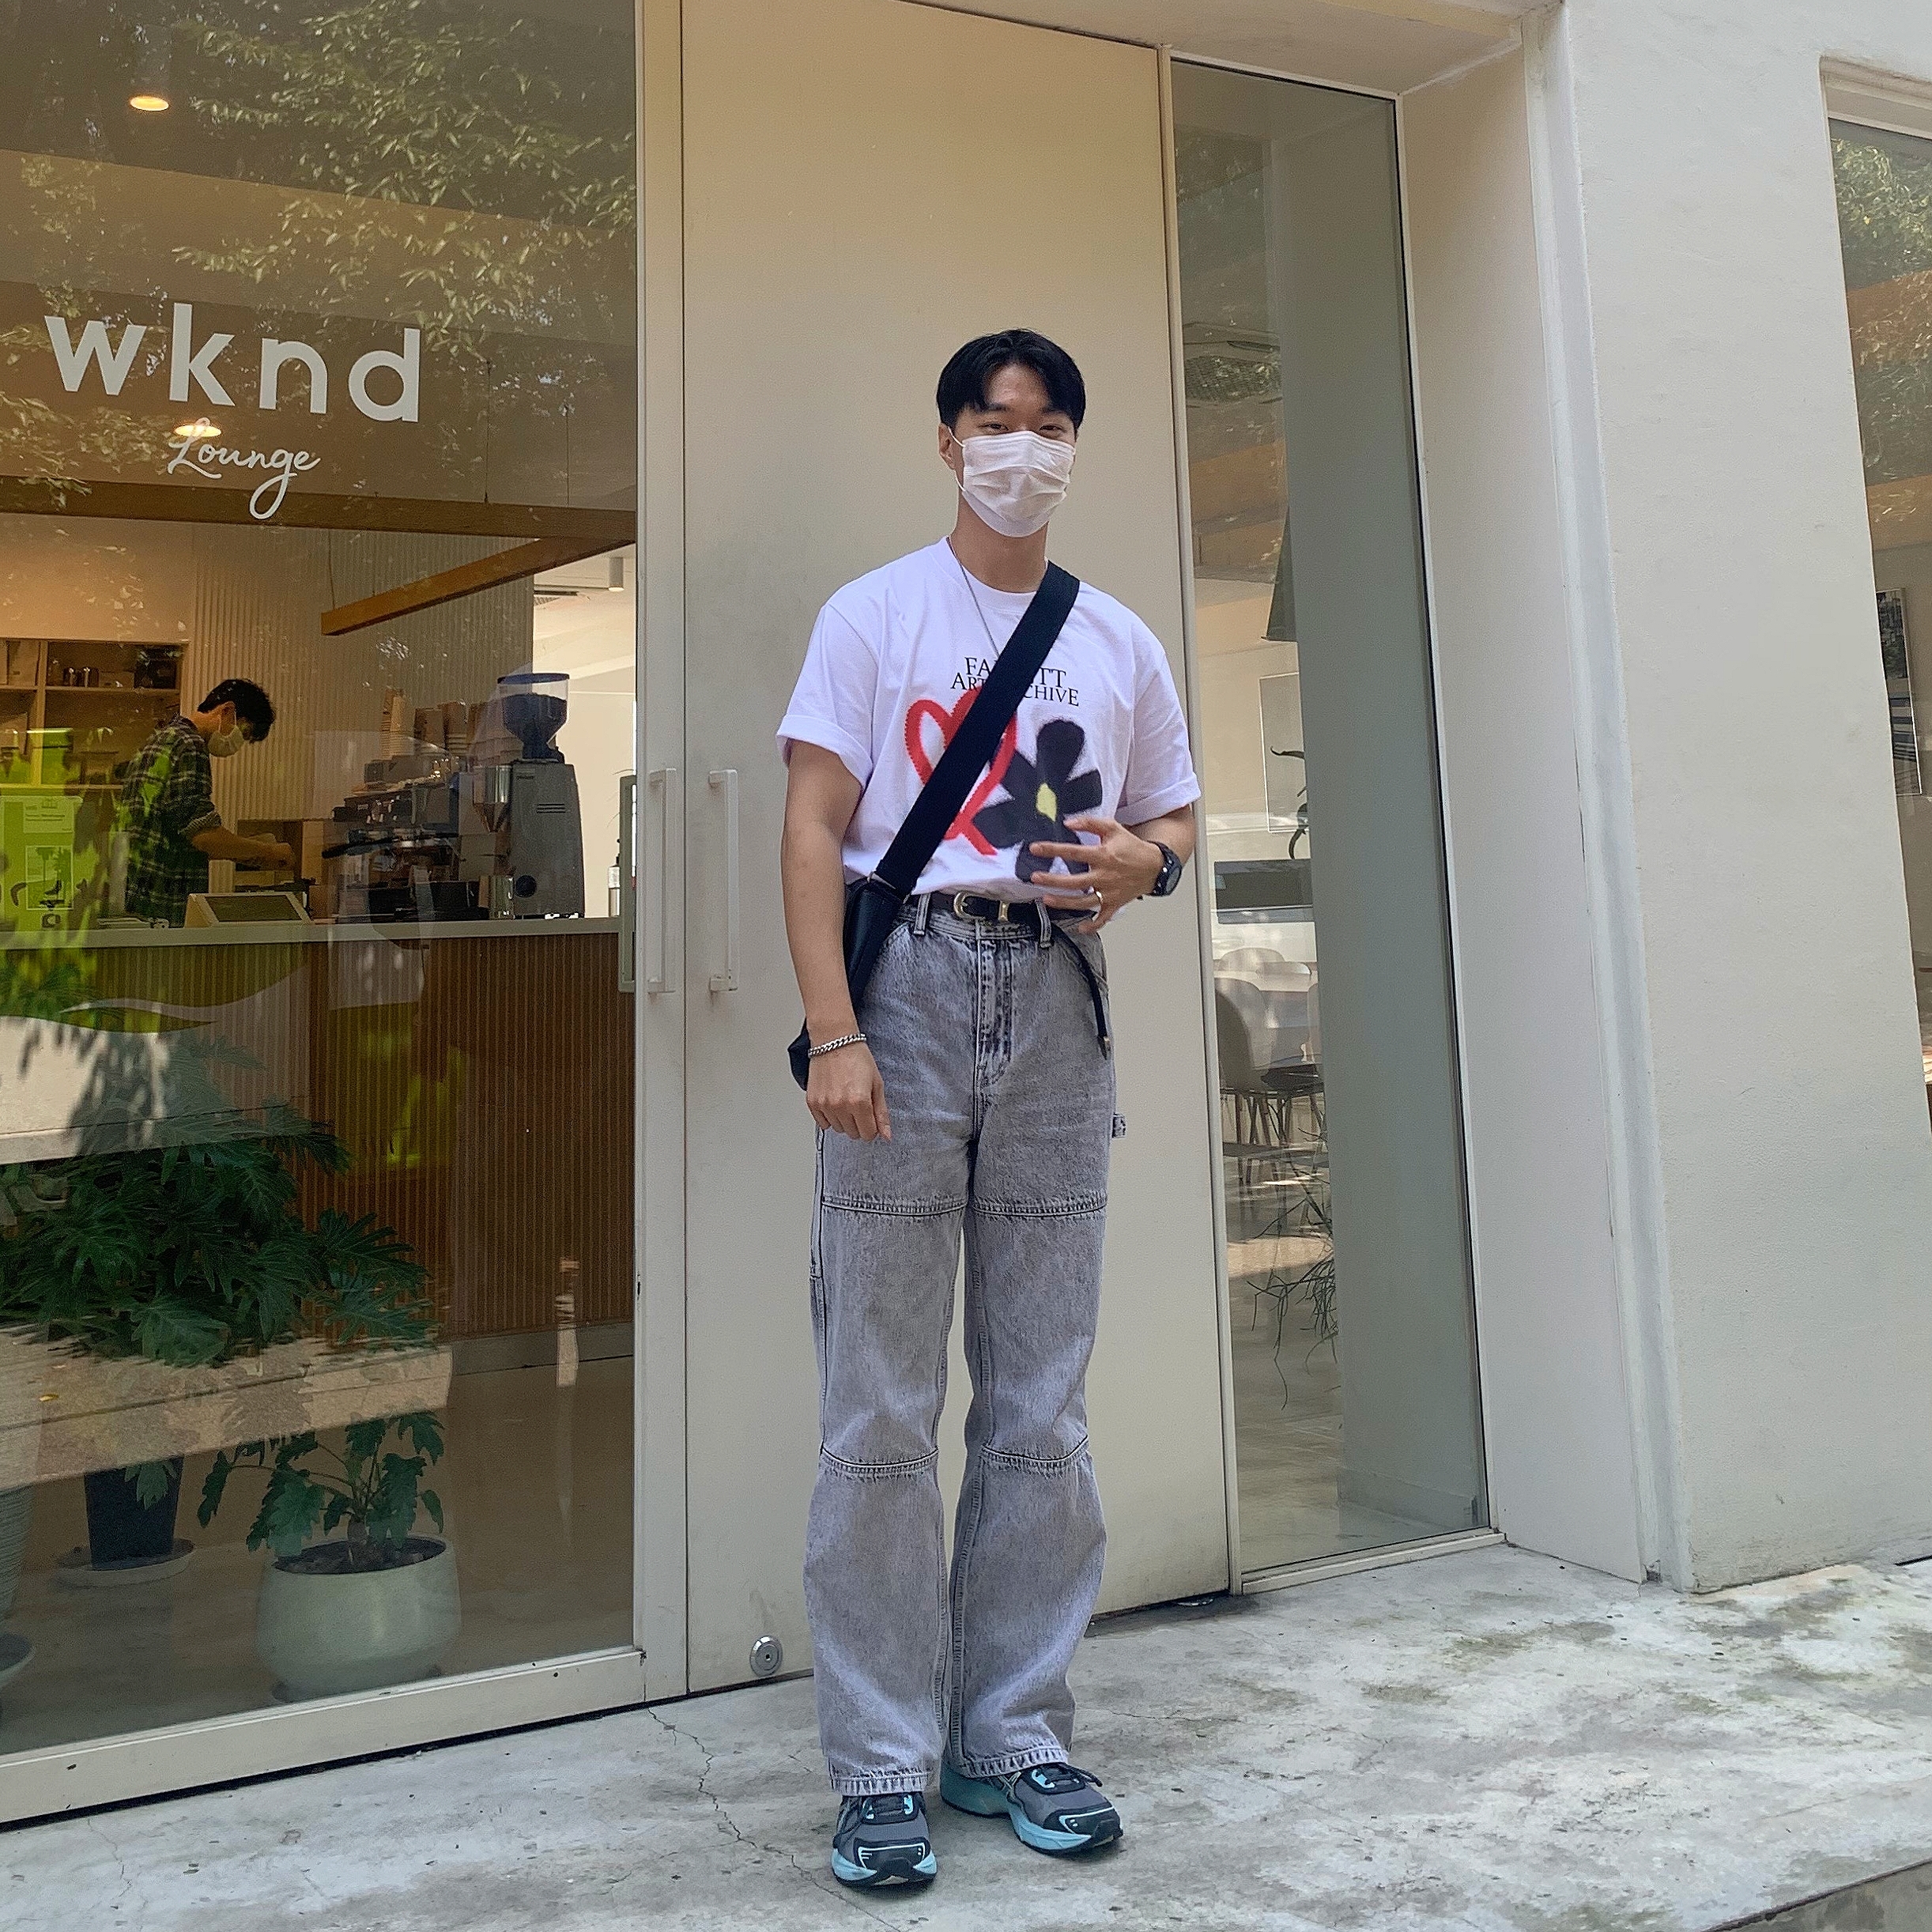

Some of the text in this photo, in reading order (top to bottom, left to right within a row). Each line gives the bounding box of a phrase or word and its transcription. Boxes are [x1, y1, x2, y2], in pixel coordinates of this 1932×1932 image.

[44, 303, 421, 422] wknd
[168, 417, 321, 520] Lounge
[964, 656, 1066, 689] FATT
